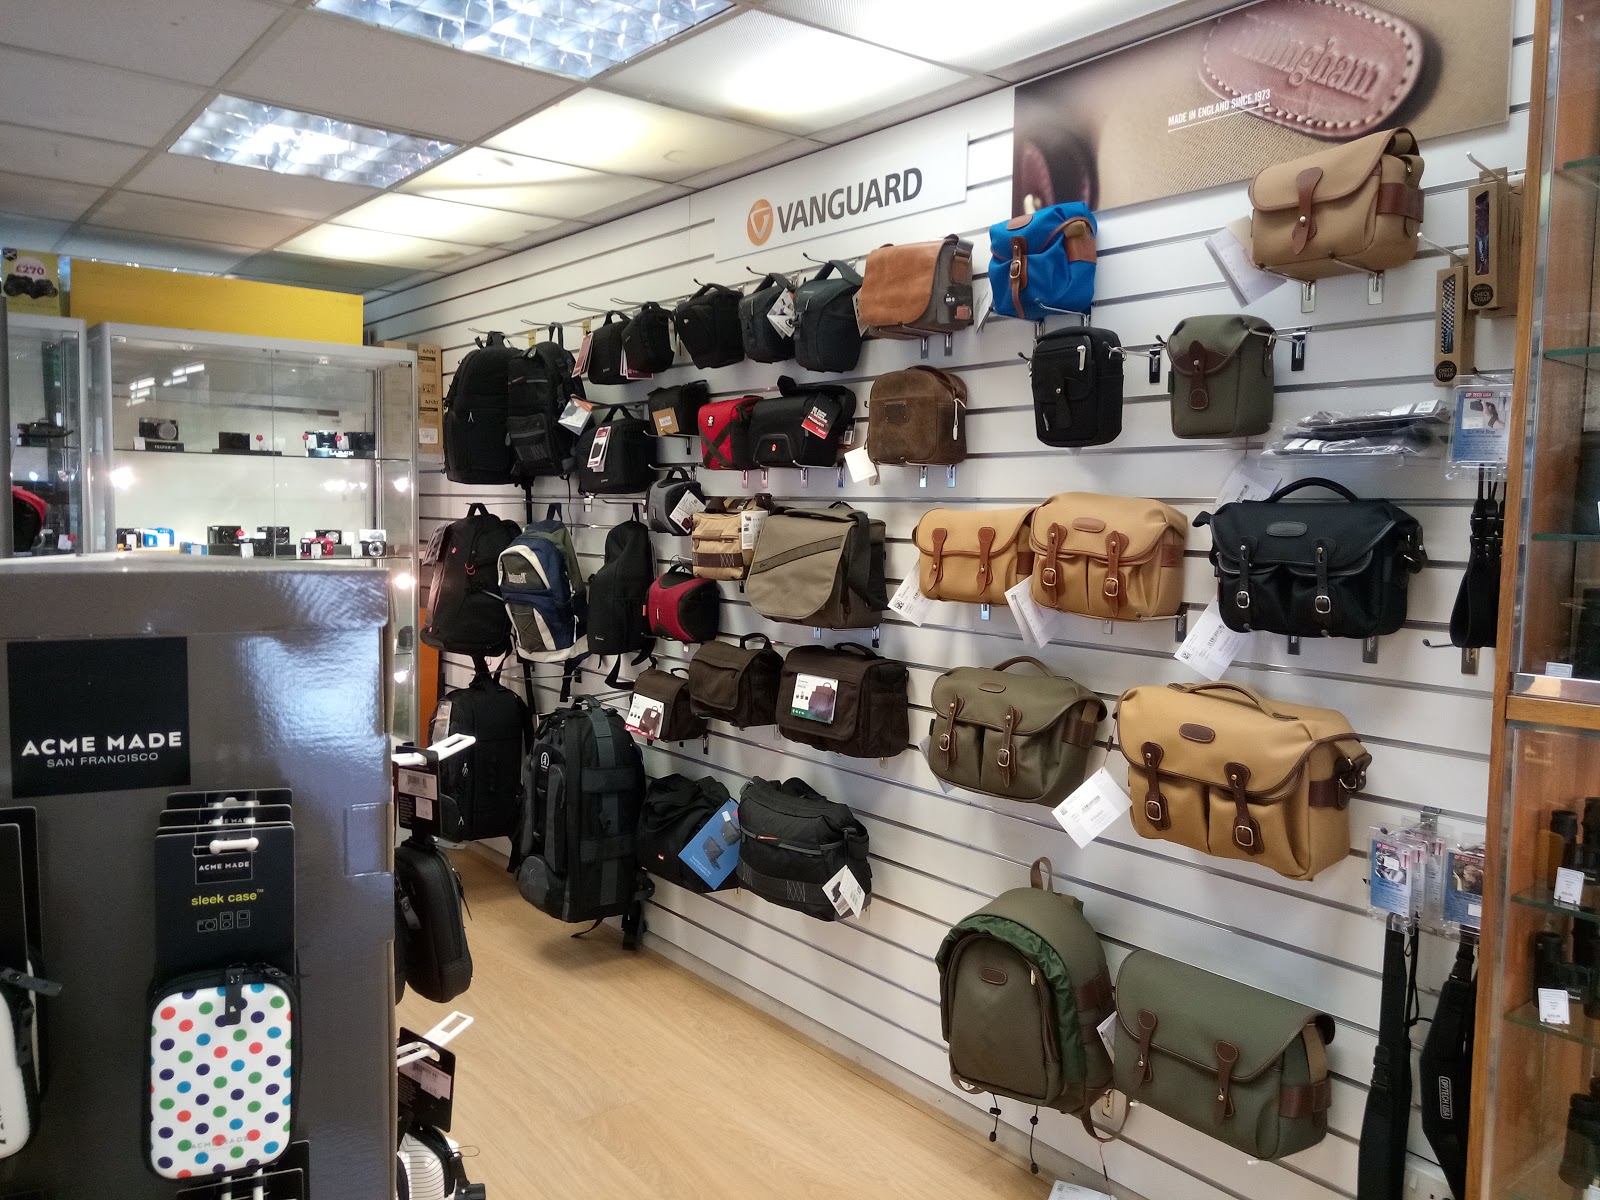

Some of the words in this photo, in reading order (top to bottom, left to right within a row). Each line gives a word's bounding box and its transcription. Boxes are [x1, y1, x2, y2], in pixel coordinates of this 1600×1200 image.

[1168, 112, 1187, 126] MADE
[1188, 109, 1197, 120] IN
[1198, 100, 1230, 118] ENGLAND
[1231, 94, 1252, 109] SINCE
[1254, 88, 1270, 102] 1973
[777, 167, 923, 233] VANGUARD
[16, 264, 45, 276] £270
[21, 736, 96, 757] ACME
[107, 731, 182, 751] MADE
[46, 757, 75, 768] SAN
[80, 752, 159, 766] FRANCISCO
[199, 863, 222, 871] ACME
[225, 861, 250, 869] MADE
[191, 894, 224, 906] sleek
[1441, 1104, 1451, 1117] USA
